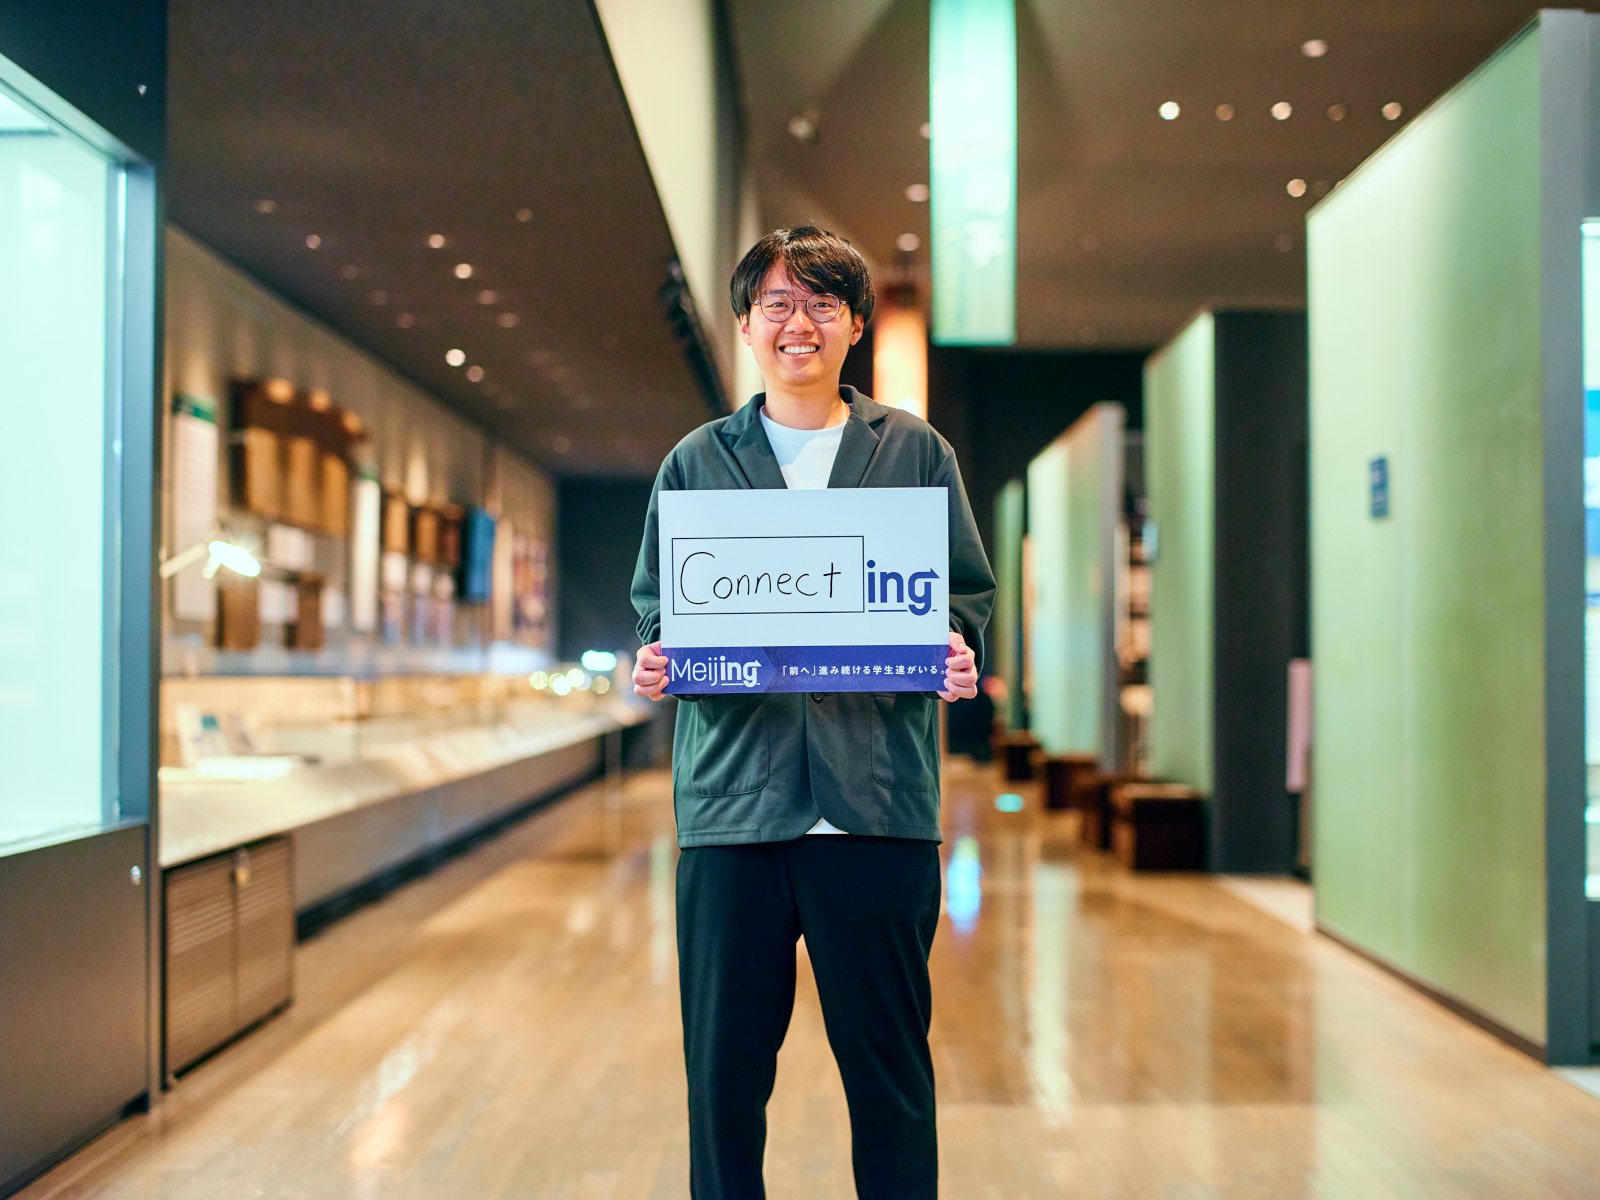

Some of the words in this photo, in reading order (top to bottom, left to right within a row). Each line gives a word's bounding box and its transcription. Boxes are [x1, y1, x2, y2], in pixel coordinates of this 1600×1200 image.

[680, 551, 842, 605] Connect
[866, 559, 941, 616] ing
[671, 655, 763, 688] Meijing
[782, 665, 945, 676] 「前へ」進み続ける学生達がいる。
